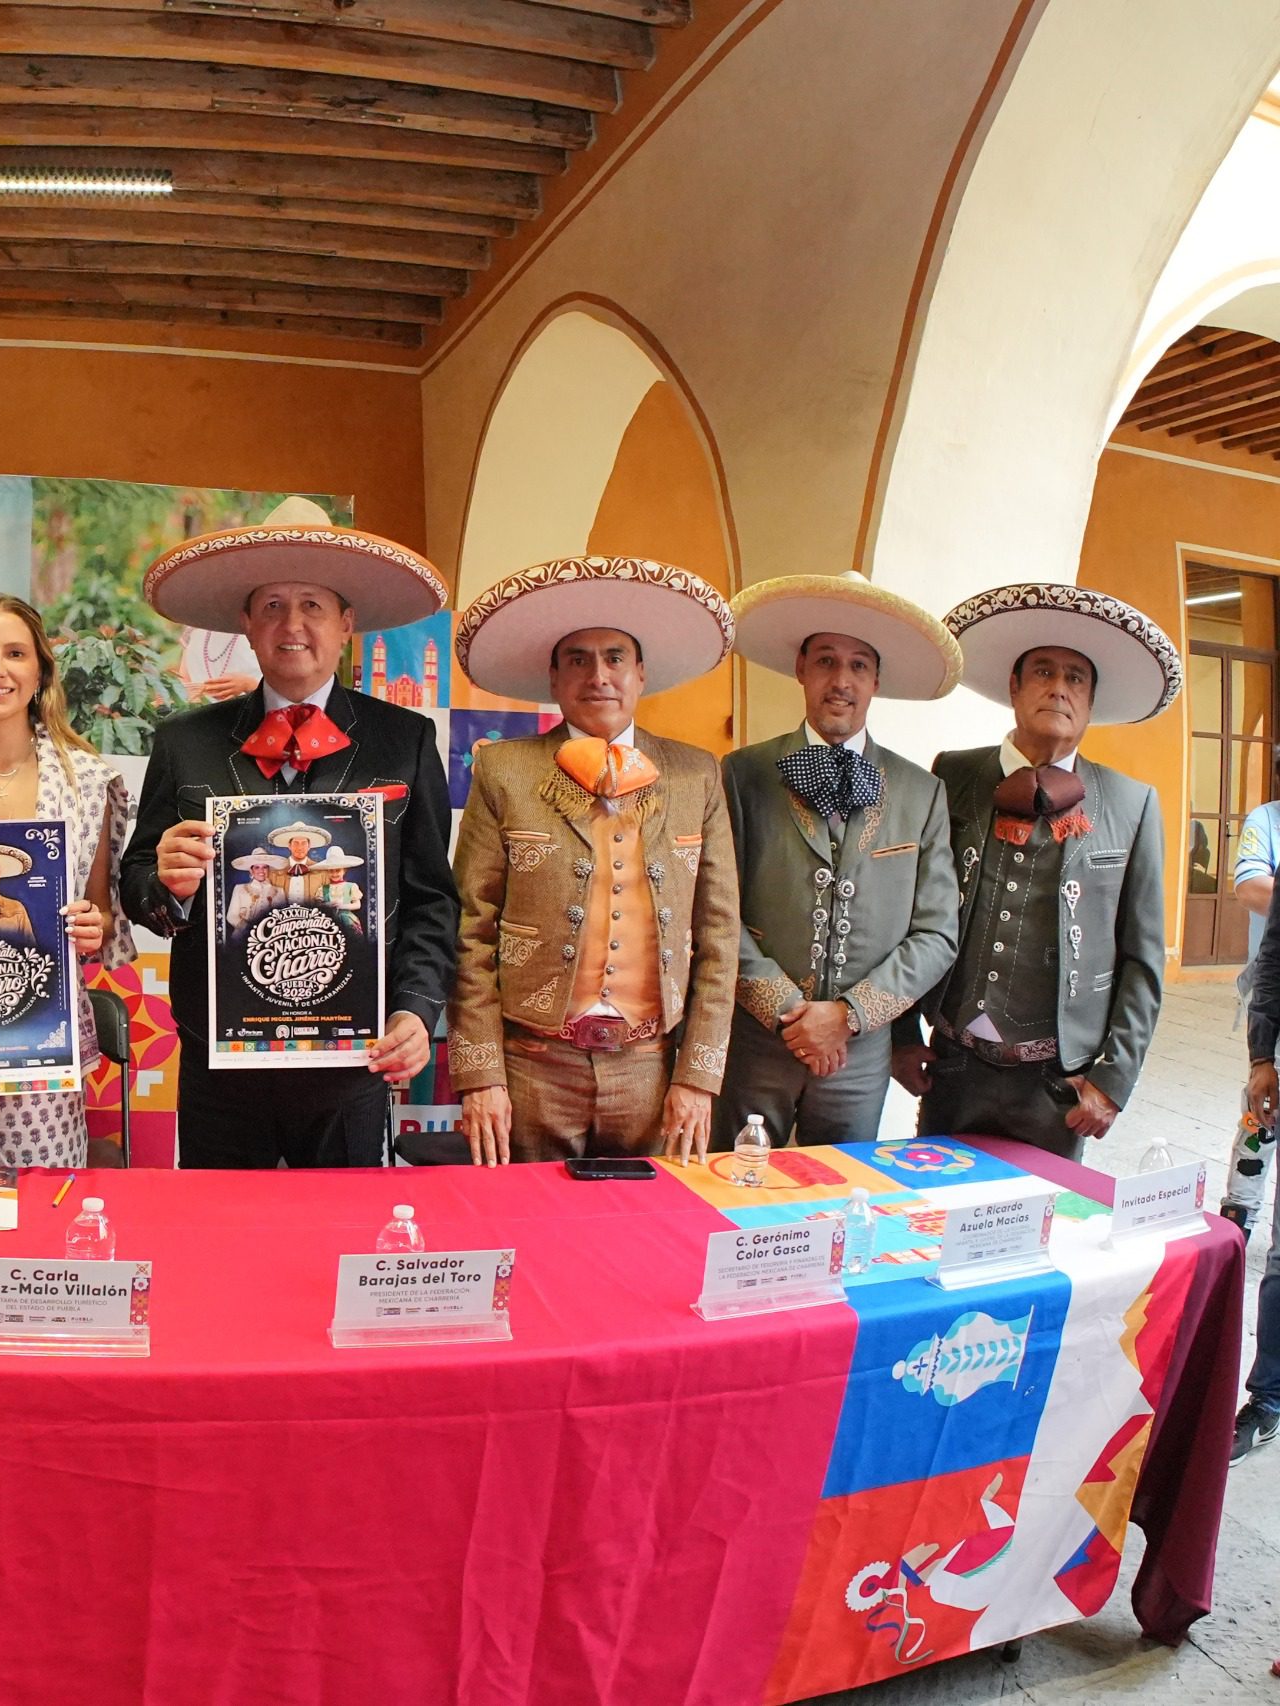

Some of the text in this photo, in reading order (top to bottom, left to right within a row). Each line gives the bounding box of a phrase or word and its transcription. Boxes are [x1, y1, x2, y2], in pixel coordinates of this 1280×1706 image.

[282, 909, 309, 919] XXXIII
[257, 915, 333, 942] Campeonato
[274, 934, 338, 957] NACIONAL
[251, 949, 339, 985] Charro
[242, 975, 265, 999] INFANTIL
[265, 996, 293, 1008] JUVENIL
[312, 973, 353, 1006] ESCARAMUZAS
[281, 981, 314, 989] PUEBLA
[283, 988, 312, 997] 2026
[1121, 1184, 1191, 1208] Invitado Especial
[973, 1202, 1023, 1218] C. Ricardo
[960, 1219, 993, 1233] Azuela
[736, 1229, 810, 1247] C. Gerónimo
[736, 1243, 810, 1261] Color Gasca
[376, 1258, 464, 1271] C. Salvador
[10, 1269, 79, 1282] C. Carla
[359, 1271, 481, 1288] Barajas del Toro
[65, 1283, 128, 1297] Villalón
